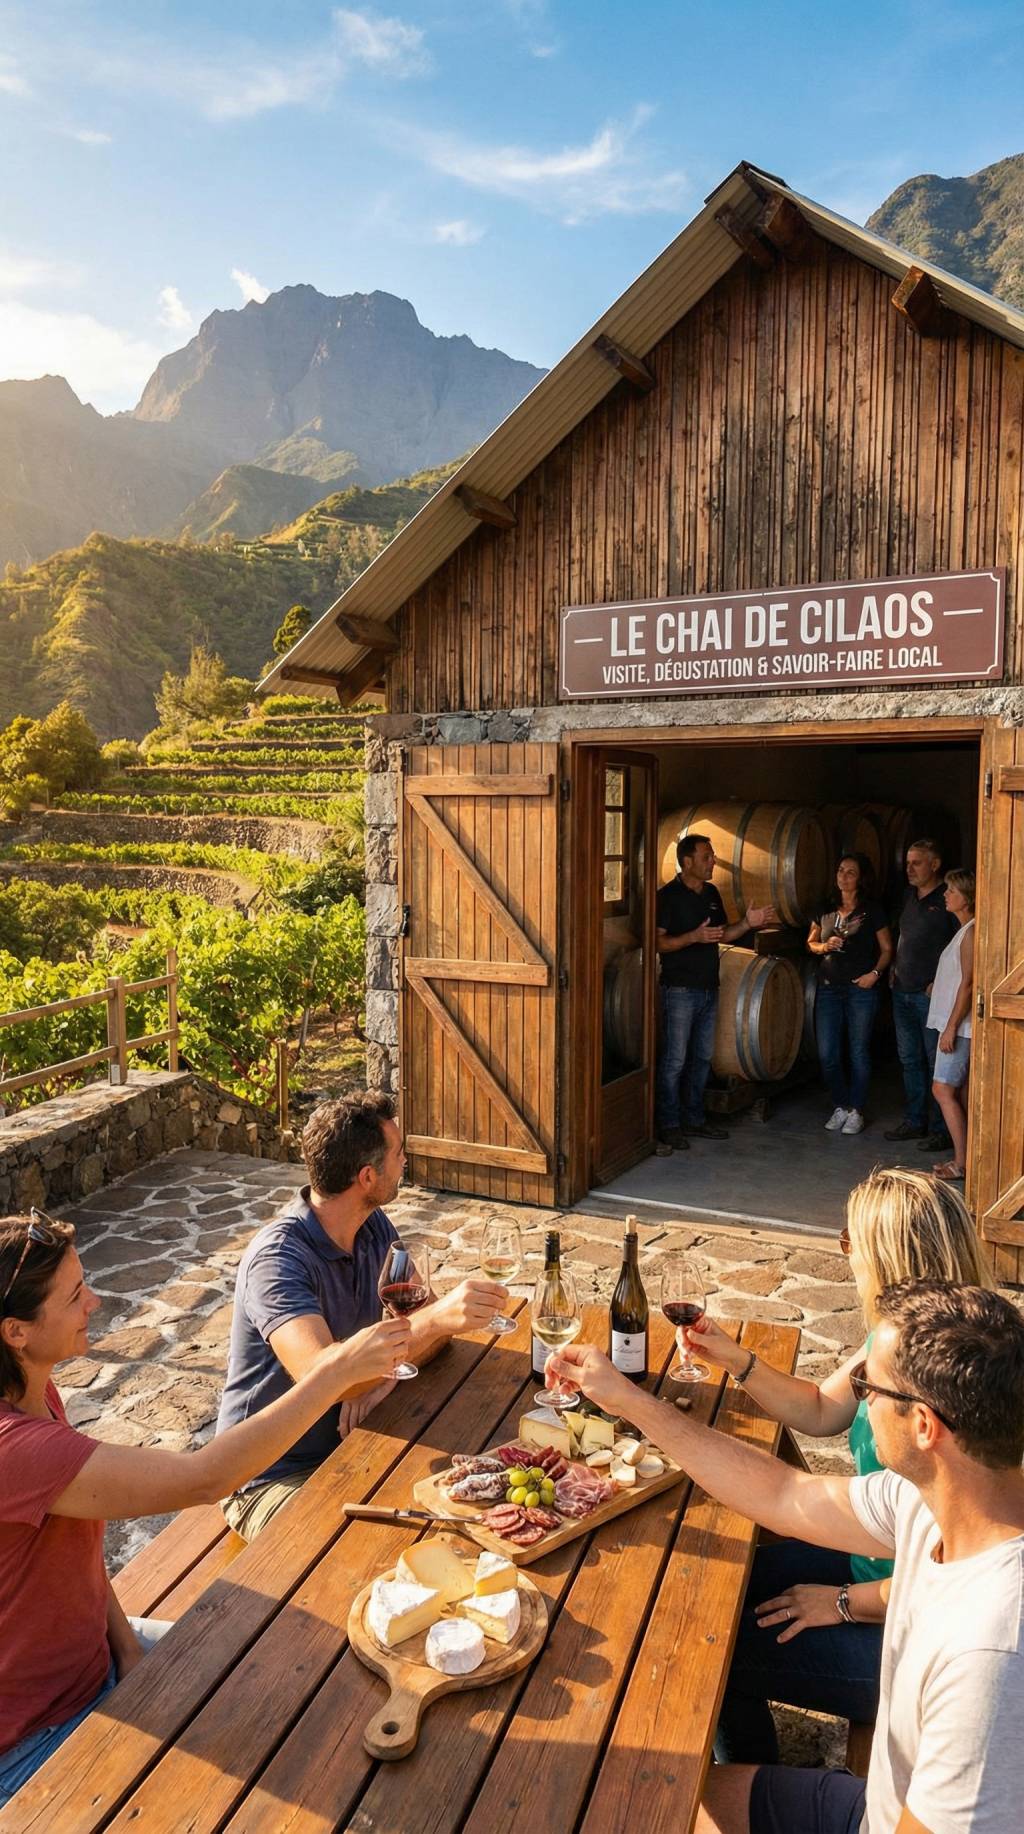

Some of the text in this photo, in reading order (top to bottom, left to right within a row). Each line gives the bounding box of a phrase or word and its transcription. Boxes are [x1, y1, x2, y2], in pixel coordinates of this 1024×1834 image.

[610, 590, 934, 658] LE CHAI DE CILAOS
[602, 645, 943, 685] VISITE, DÉGUSTATION & SAVOIR-FAIRE LOCAL
